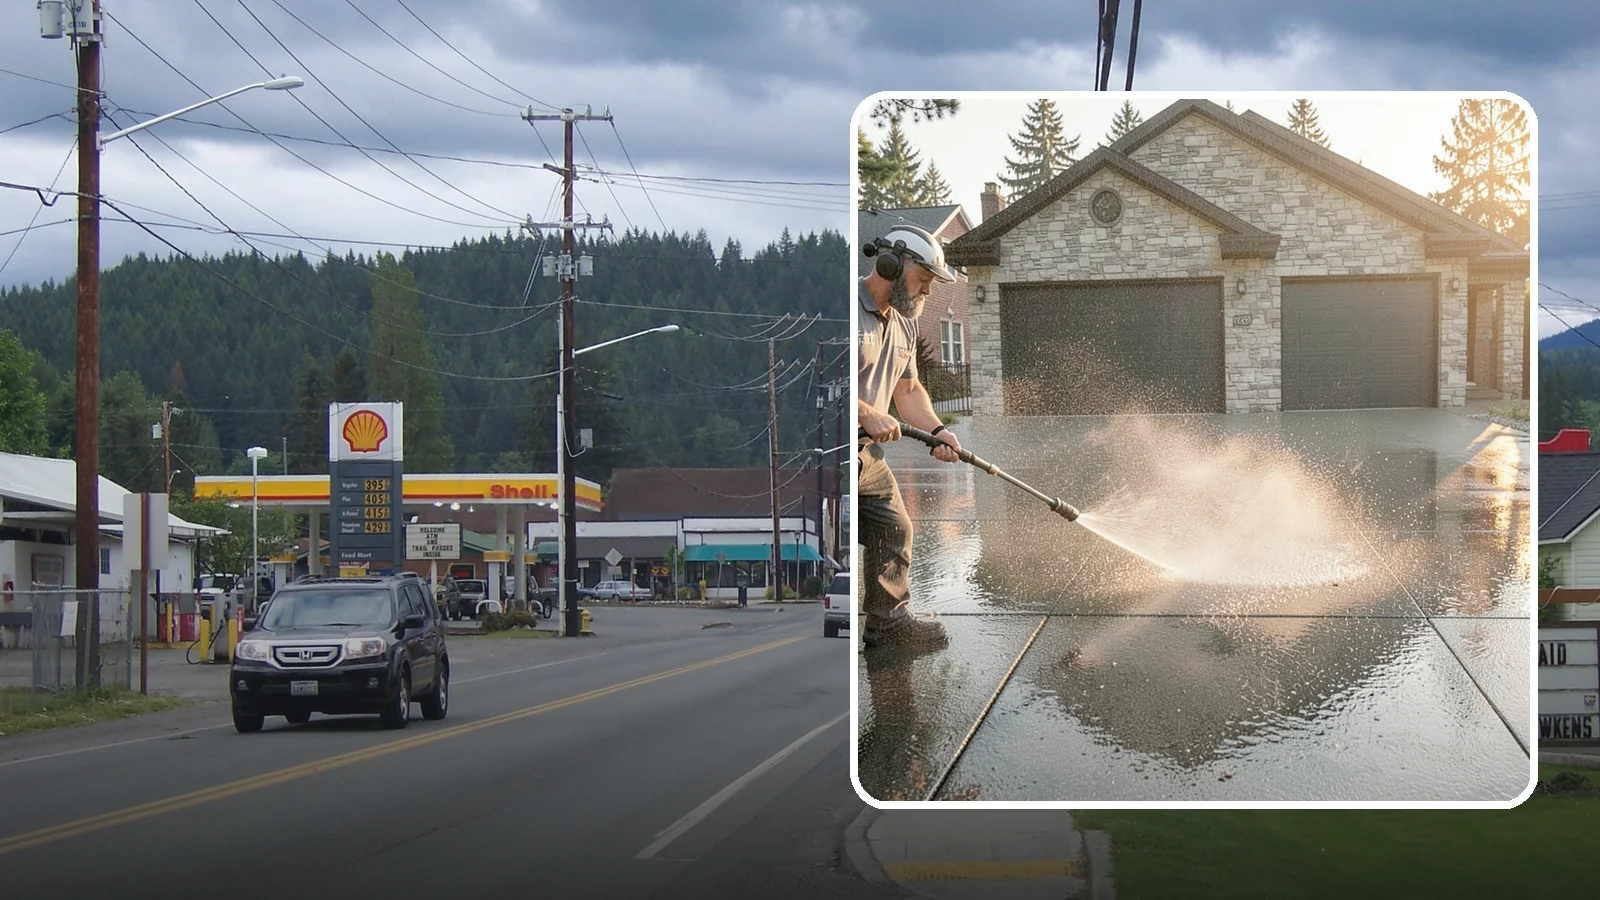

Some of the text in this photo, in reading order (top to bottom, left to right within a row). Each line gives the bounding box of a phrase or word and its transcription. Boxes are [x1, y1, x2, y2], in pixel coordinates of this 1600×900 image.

[366, 480, 383, 490] 395
[490, 484, 547, 499] Shell
[366, 494, 383, 504] 405
[366, 508, 383, 518] 415
[366, 522, 383, 532] 429
